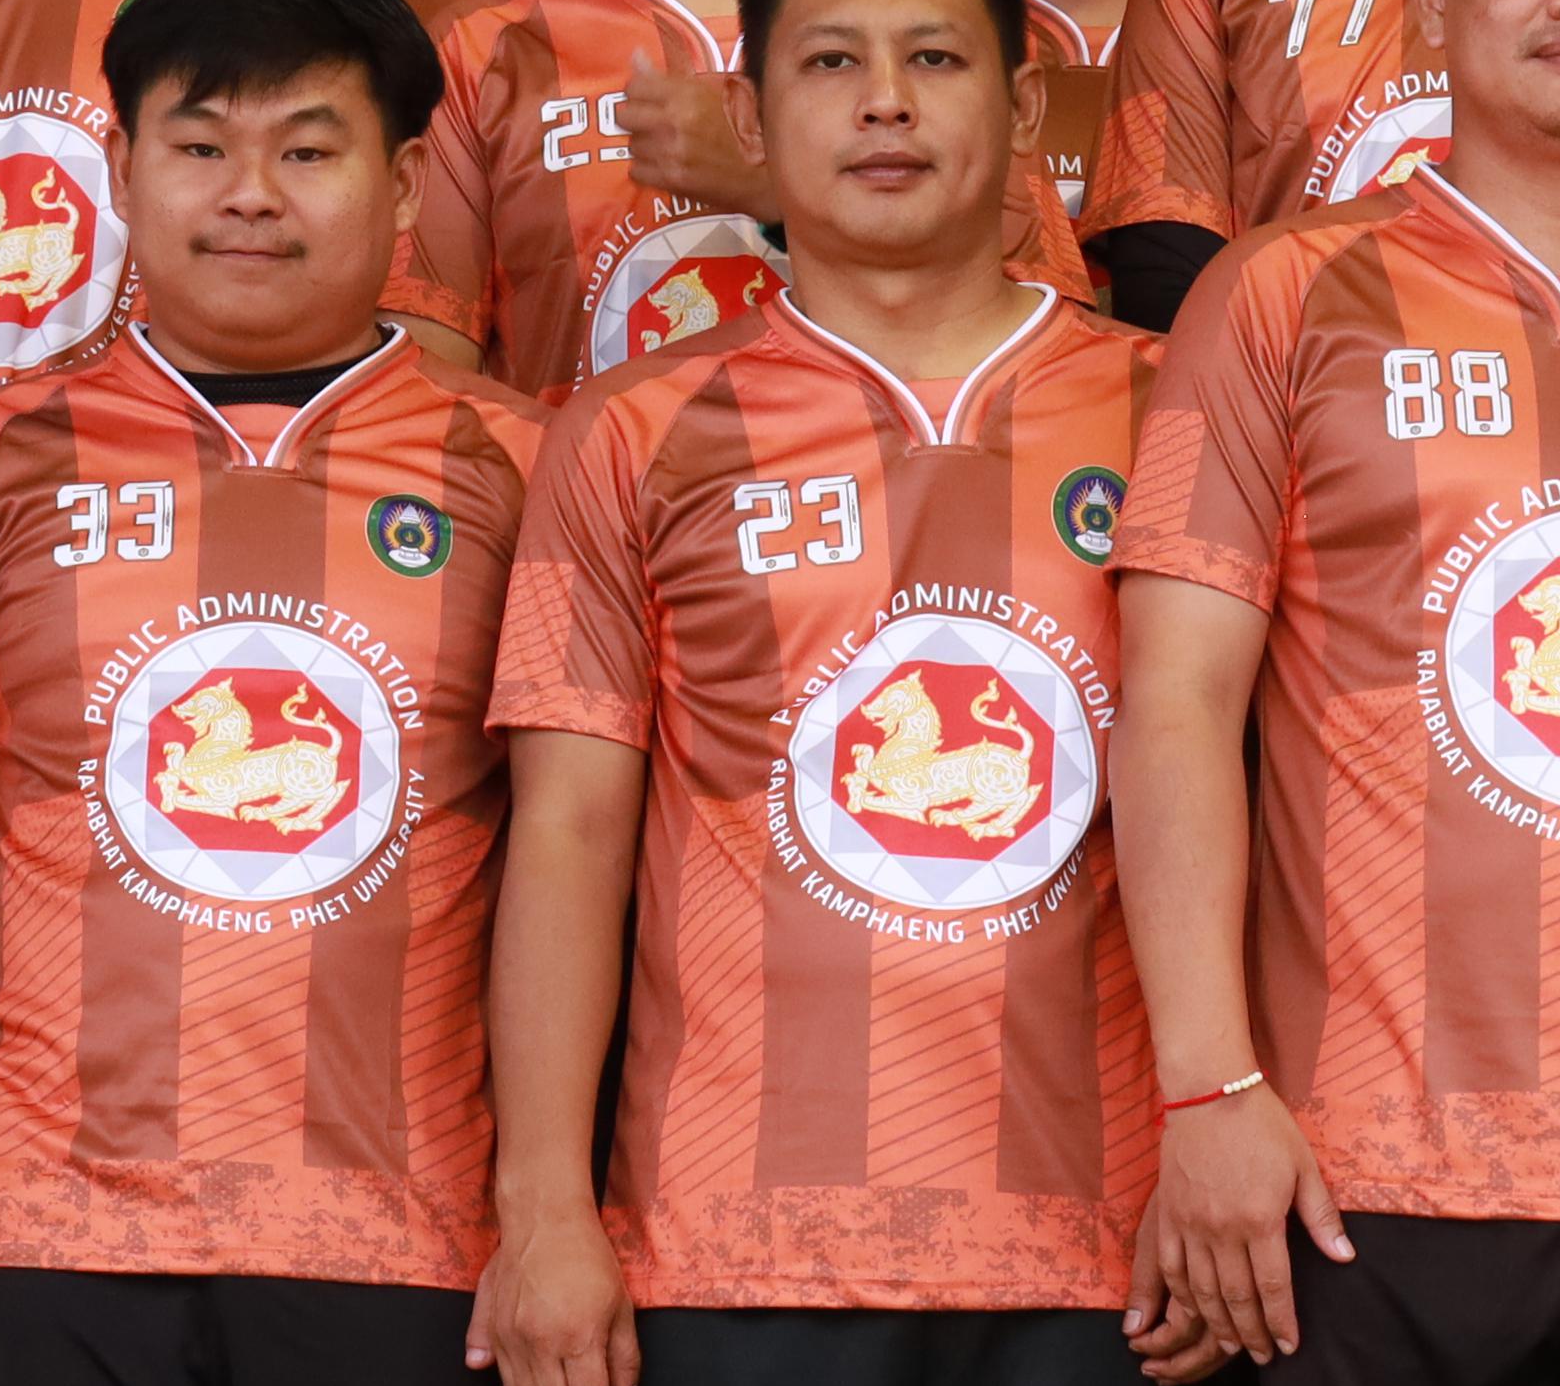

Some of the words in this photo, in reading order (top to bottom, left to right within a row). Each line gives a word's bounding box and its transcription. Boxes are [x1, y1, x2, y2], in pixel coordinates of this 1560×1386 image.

[1304, 95, 1378, 198] PUBLIC
[1381, 348, 1515, 441] 88
[52, 480, 176, 568] 33
[733, 474, 865, 575] 23
[1422, 501, 1514, 615] PUBLIC
[82, 619, 168, 726] PUBLIC
[176, 591, 426, 730] ADMINISTRATION
[874, 582, 1120, 732] ADMINISTRATION
[118, 866, 273, 934] KAMPHAENG
[290, 894, 353, 932] PHET
[353, 768, 426, 903] UNIVERSITY
[800, 870, 966, 944] KAMPHAENG
[984, 901, 1042, 941] PHET
